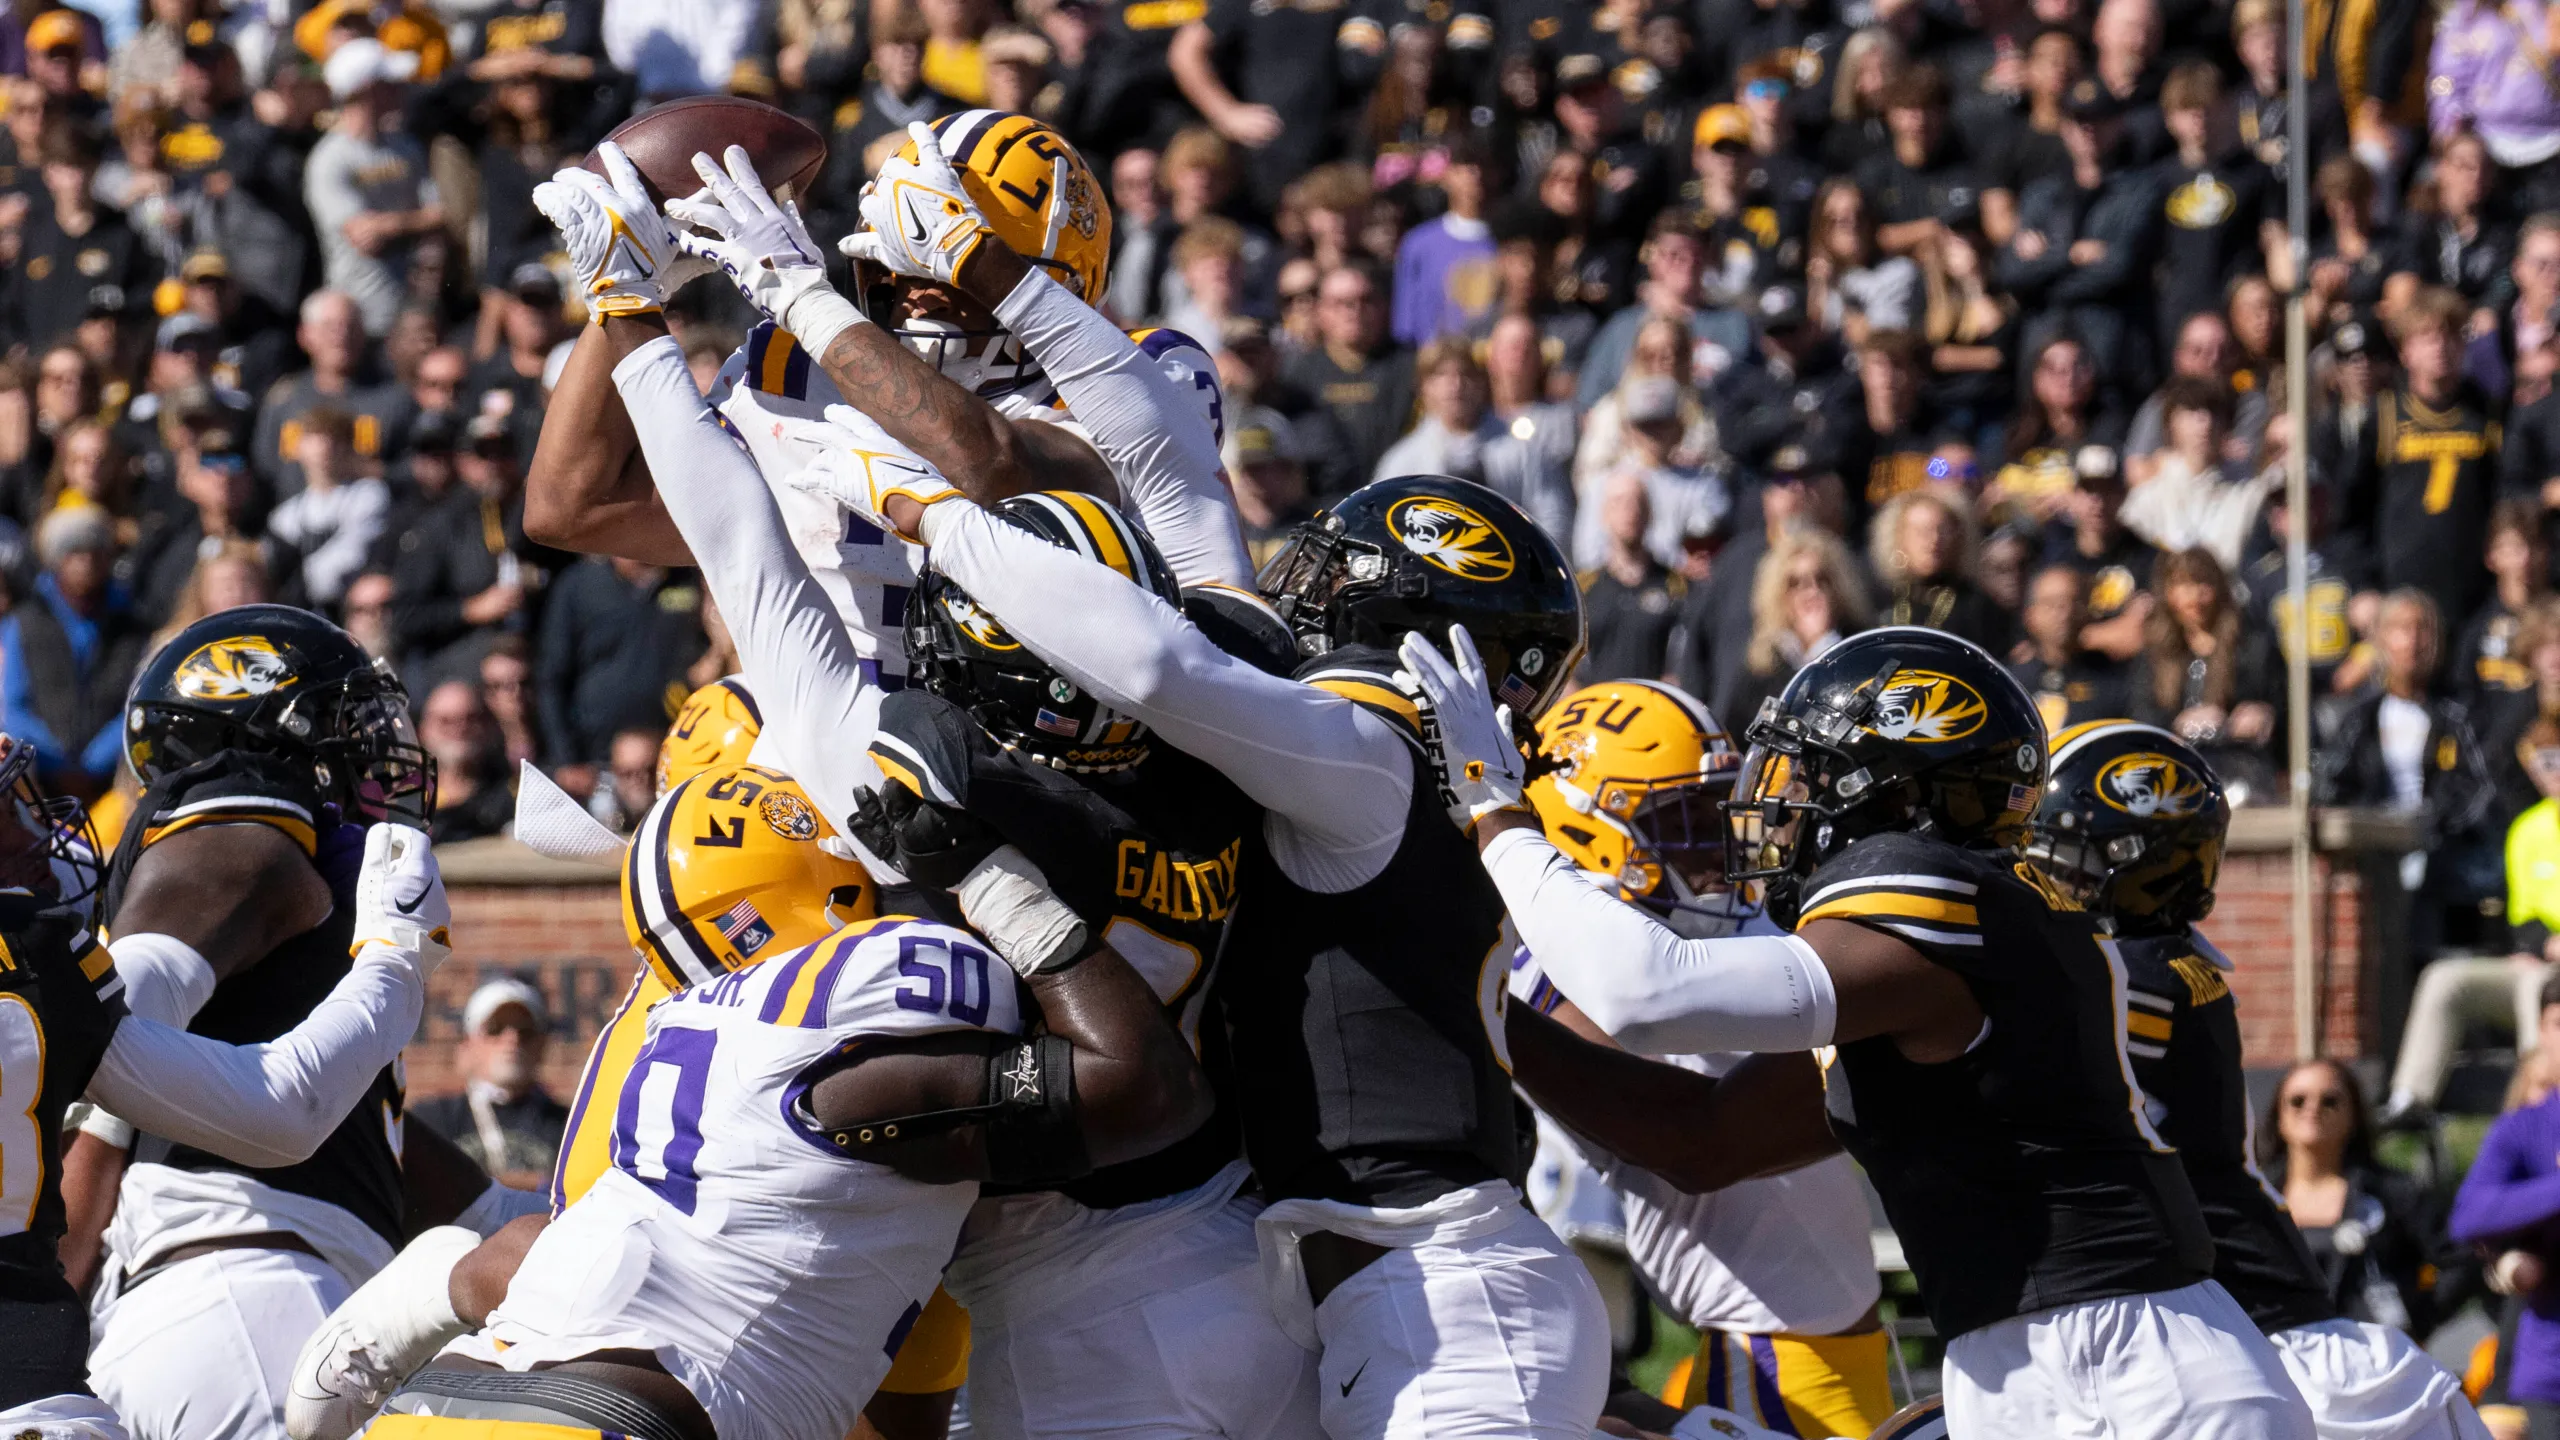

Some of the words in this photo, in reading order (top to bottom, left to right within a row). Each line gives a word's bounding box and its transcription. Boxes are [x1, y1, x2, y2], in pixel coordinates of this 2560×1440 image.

[1540, 697, 1643, 735] SU
[1115, 836, 1241, 921] GADDY
[698, 960, 766, 1008] JR.
[895, 936, 990, 1028] 50
[1783, 965, 1800, 1019] DRI-FIT
[1018, 1044, 1036, 1083] Douglas
